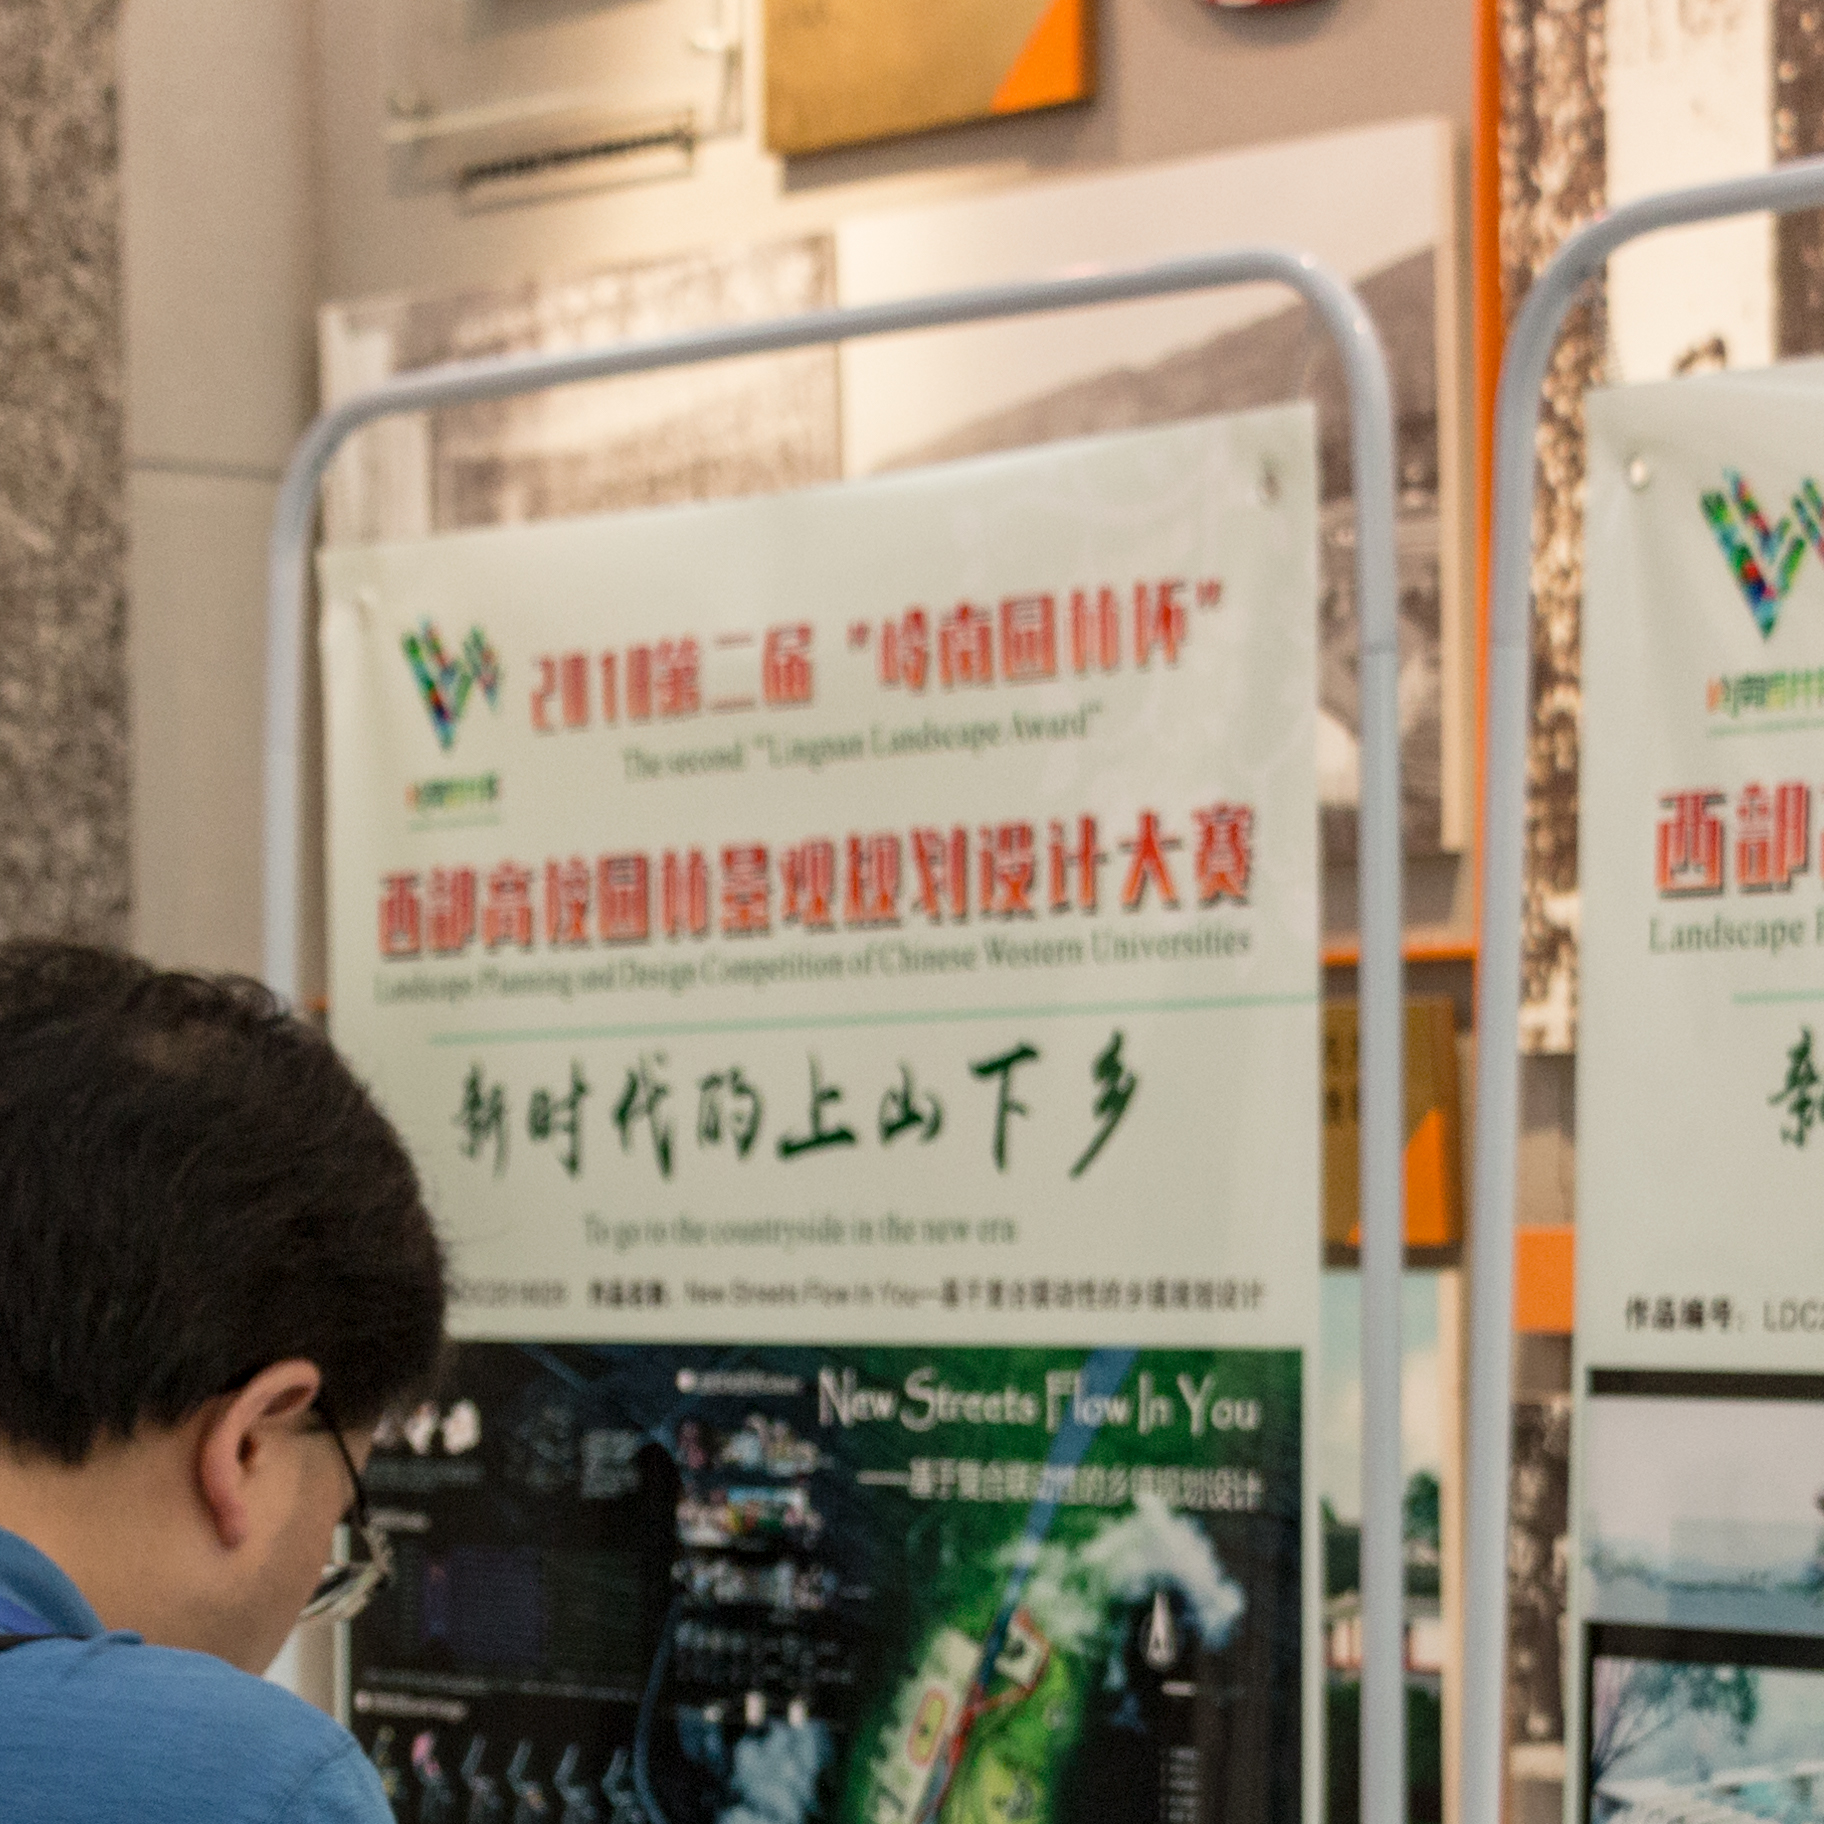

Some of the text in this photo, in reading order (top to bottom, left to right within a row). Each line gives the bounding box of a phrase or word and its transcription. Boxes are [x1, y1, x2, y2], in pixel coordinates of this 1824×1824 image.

[622, 745, 662, 783] The
[665, 739, 745, 776] second
[870, 718, 1001, 759] Landscape
[375, 923, 1253, 1008] Landscape Planning and Design Competition of Chinese Western Universities
[1648, 910, 1808, 956] Landscape
[450, 1026, 1140, 1182] 新时代的上山下乡
[583, 1211, 1017, 1256] To go to the countryside in the new era
[817, 1365, 1263, 1439] New Streets Flow In You
